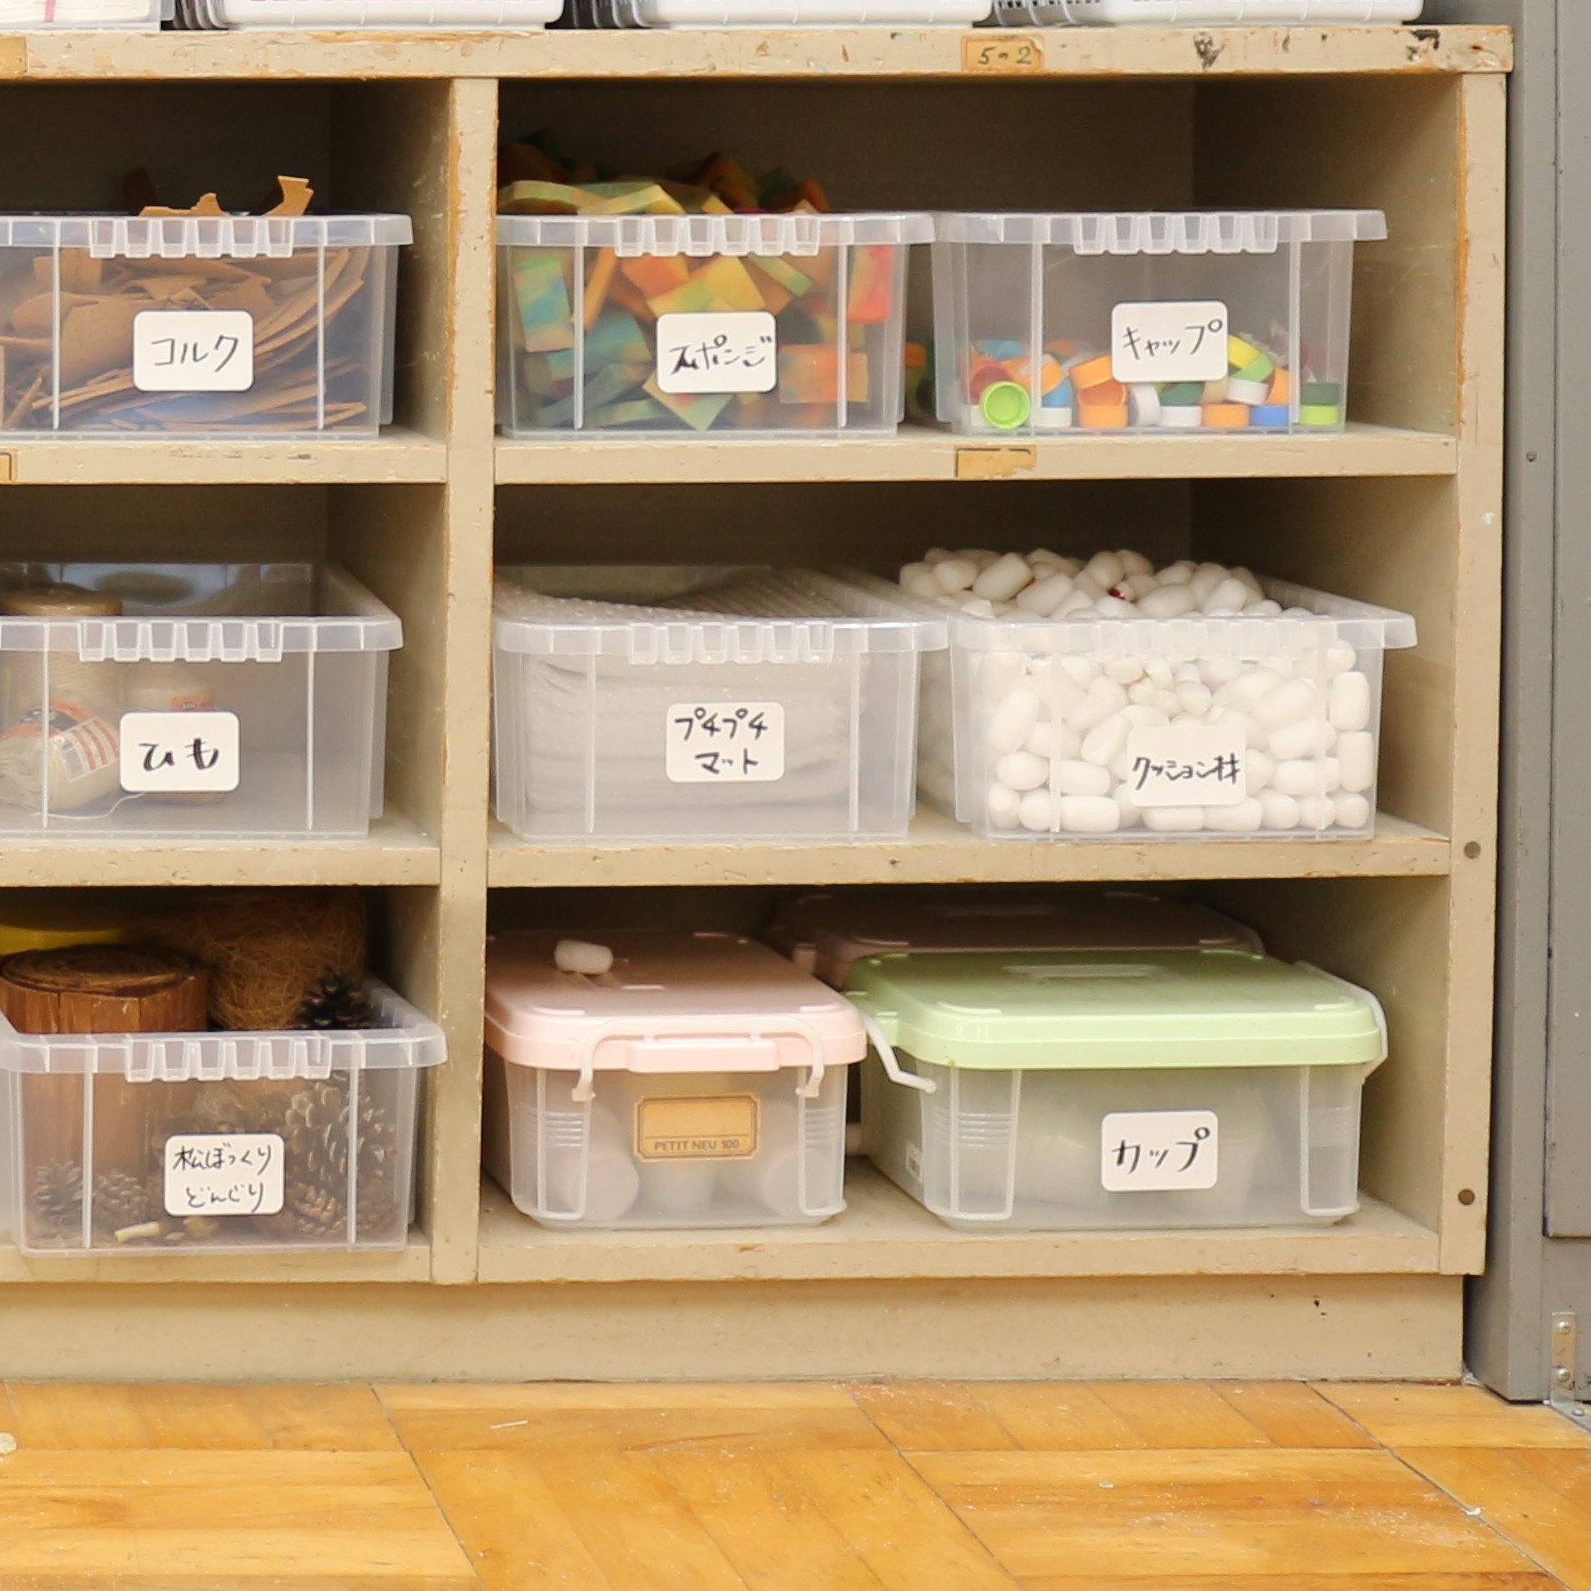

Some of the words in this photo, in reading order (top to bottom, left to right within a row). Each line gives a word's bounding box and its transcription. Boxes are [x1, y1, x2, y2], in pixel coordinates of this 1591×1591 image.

[150, 335, 241, 373] コルク
[669, 333, 774, 377] スポンジ
[1122, 318, 1225, 361] キャップ
[138, 736, 220, 772] ひも
[694, 747, 760, 775] マット
[1131, 751, 1241, 792] クッション材
[172, 1141, 273, 1178] 松ぼっくり
[654, 1140, 688, 1152] PETIT
[692, 1140, 717, 1152] NEU
[721, 1138, 741, 1151] 100
[1110, 1125, 1212, 1175] カップ
[186, 1182, 265, 1215] どんぐり
